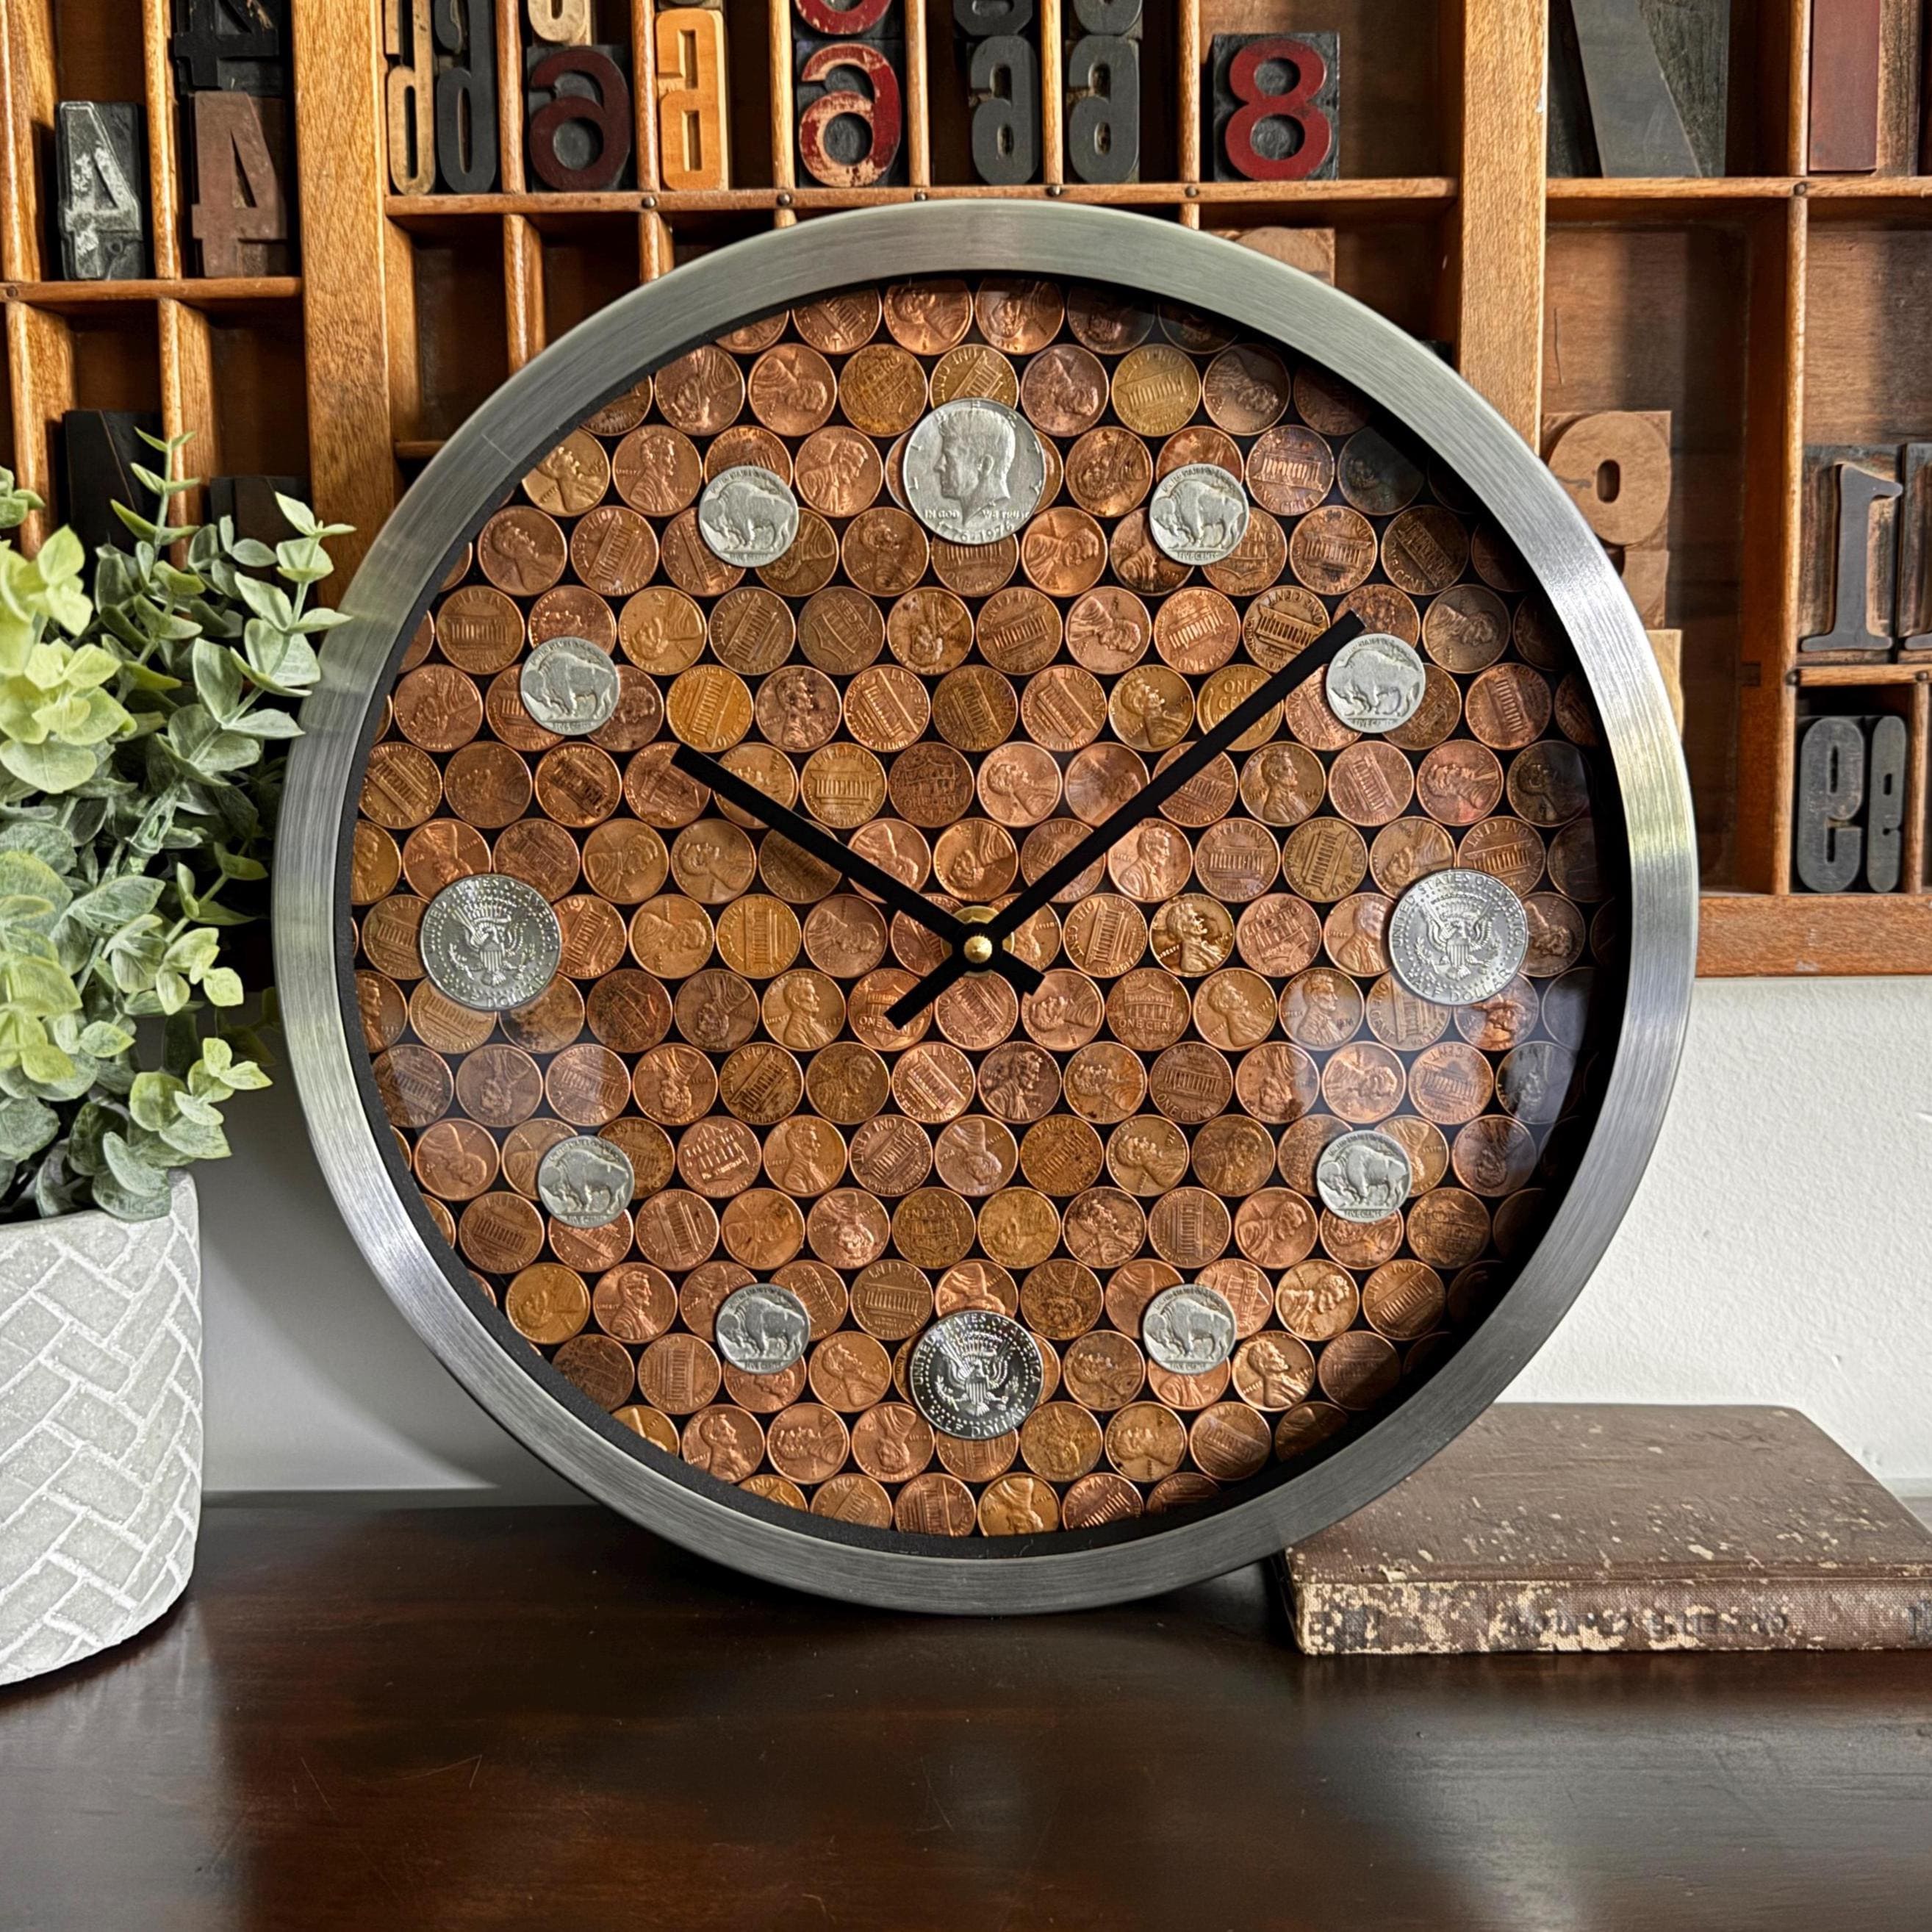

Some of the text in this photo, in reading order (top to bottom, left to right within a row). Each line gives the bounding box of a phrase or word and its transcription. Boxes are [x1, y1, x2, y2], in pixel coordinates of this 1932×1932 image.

[1225, 39, 1332, 181] 8
[1177, 552, 1195, 560] FIVE
[1391, 894, 1416, 948] UNITED
[1418, 873, 1470, 894] STATES
[1449, 969, 1512, 1002] DOLLAR
[914, 1335, 936, 1385] UNITED
